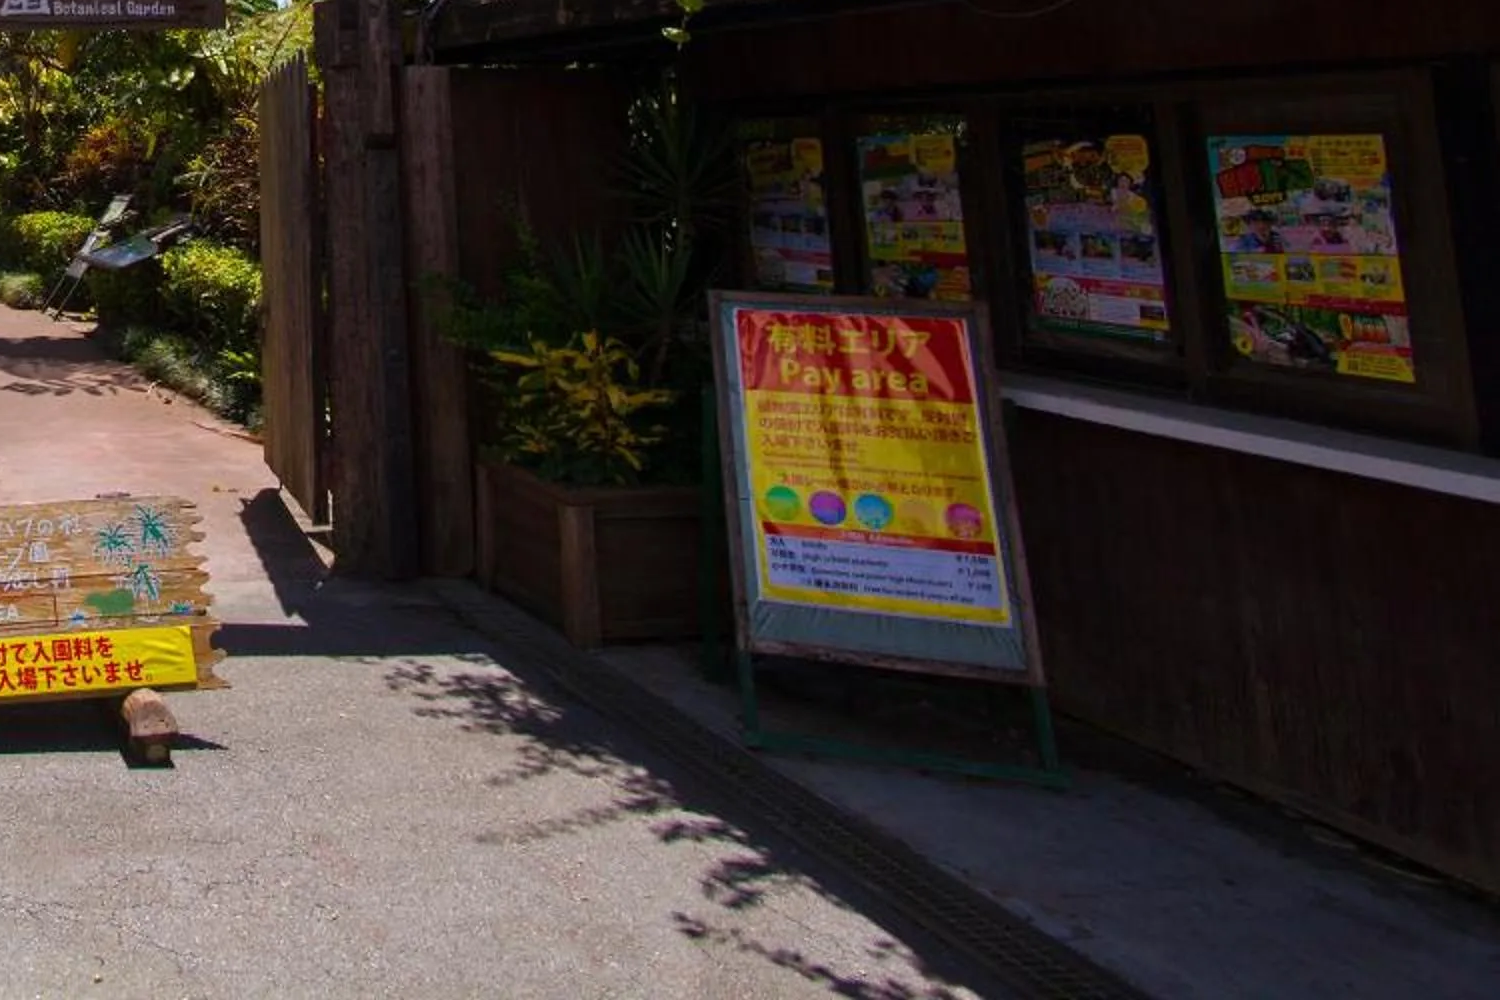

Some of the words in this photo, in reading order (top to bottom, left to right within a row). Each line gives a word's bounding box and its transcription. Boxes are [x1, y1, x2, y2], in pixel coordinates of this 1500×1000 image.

[52, 0, 121, 16] Botanical
[126, 0, 177, 16] Garden
[766, 322, 932, 360] 有料エリア
[779, 358, 841, 395] Pay
[850, 367, 929, 394] area
